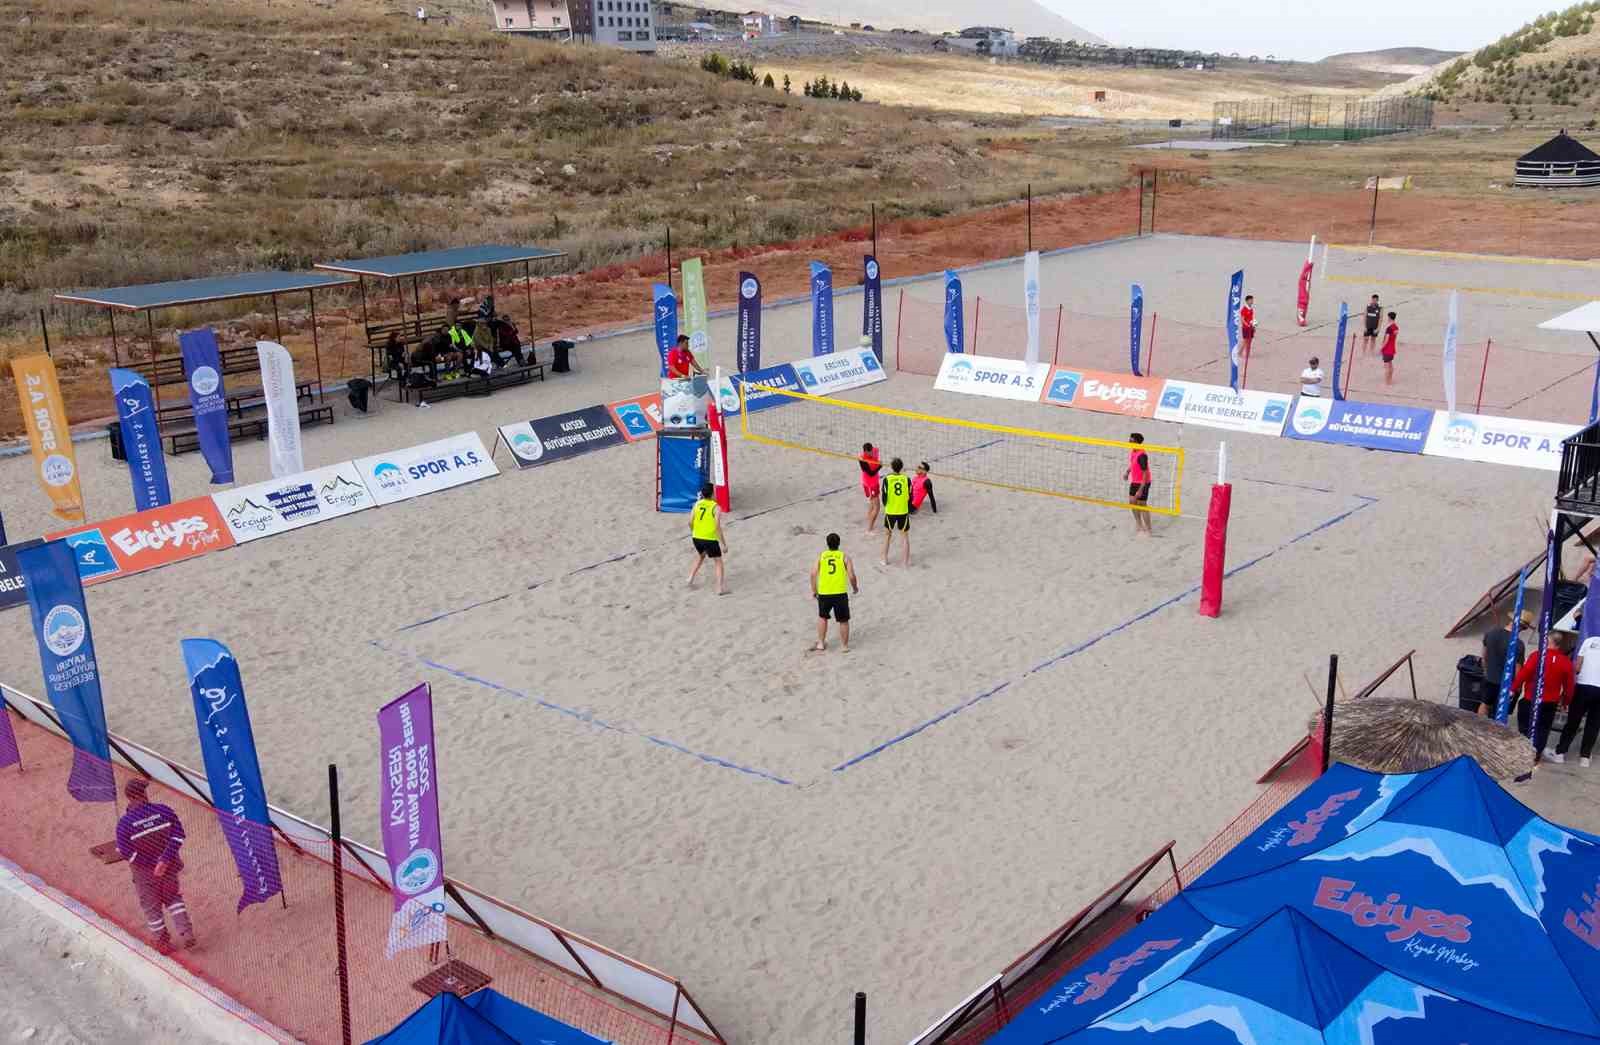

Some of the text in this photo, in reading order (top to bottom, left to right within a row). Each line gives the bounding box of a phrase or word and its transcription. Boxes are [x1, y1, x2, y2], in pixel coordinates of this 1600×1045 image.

[973, 370, 1008, 385] SPOR
[1083, 379, 1147, 405] Erciyes
[1185, 403, 1215, 416] KAYAK
[1342, 412, 1412, 430] KAYSERİ
[1481, 432, 1531, 450] SPOR
[408, 458, 450, 480] SPOR
[894, 482, 902, 496] 8
[325, 489, 364, 508] Erciyes
[231, 513, 273, 531] Erciyes
[699, 507, 706, 520] 7
[111, 515, 209, 555] Erciyes
[828, 558, 836, 575] 5
[1312, 876, 1473, 943] Erciyes
